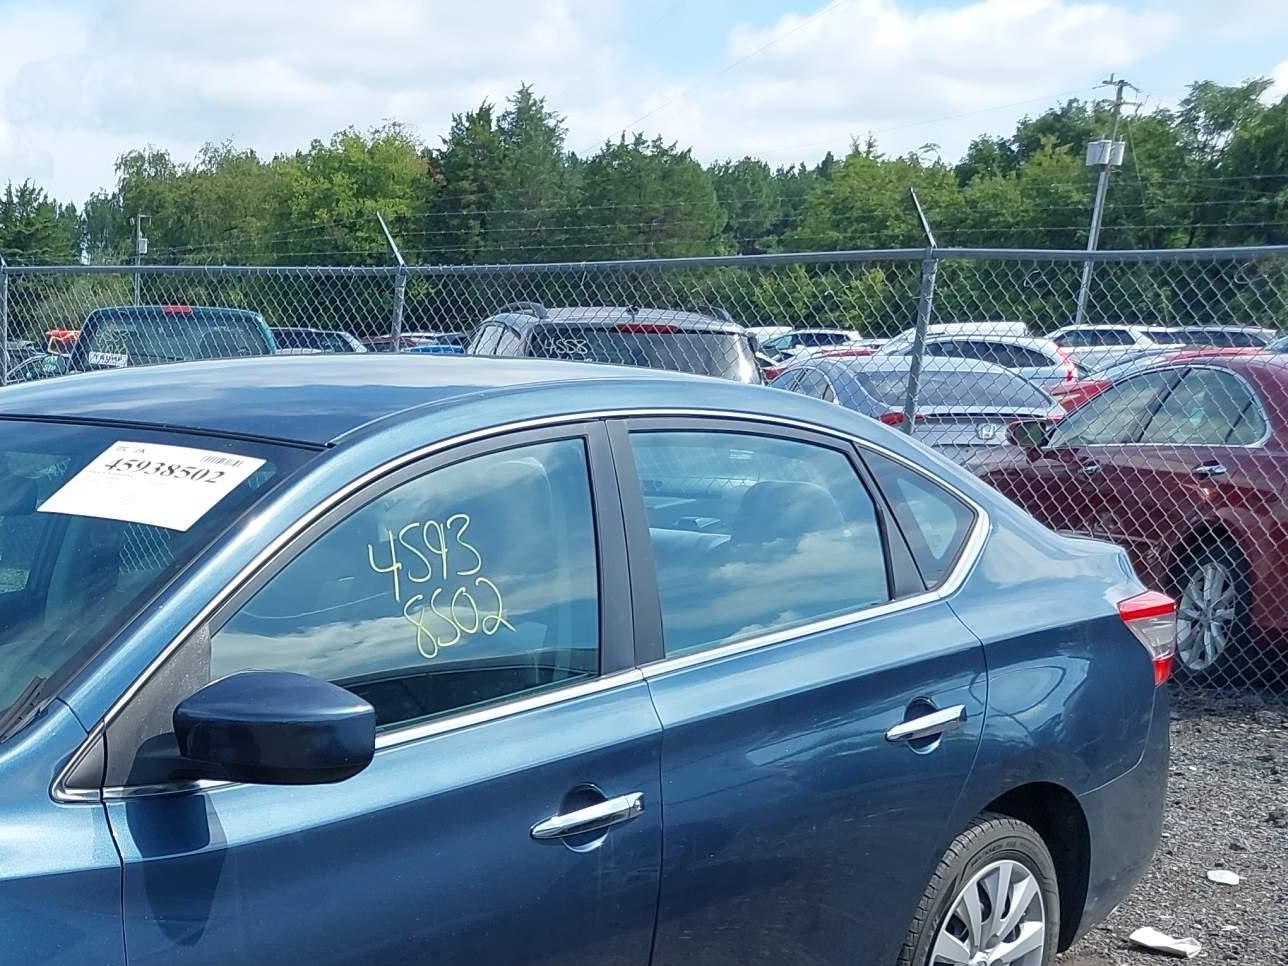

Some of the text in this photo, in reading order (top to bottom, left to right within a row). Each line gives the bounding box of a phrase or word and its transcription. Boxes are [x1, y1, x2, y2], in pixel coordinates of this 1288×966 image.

[105, 458, 225, 484] 45938502
[367, 513, 482, 603] 4593
[403, 577, 517, 659] 8502
